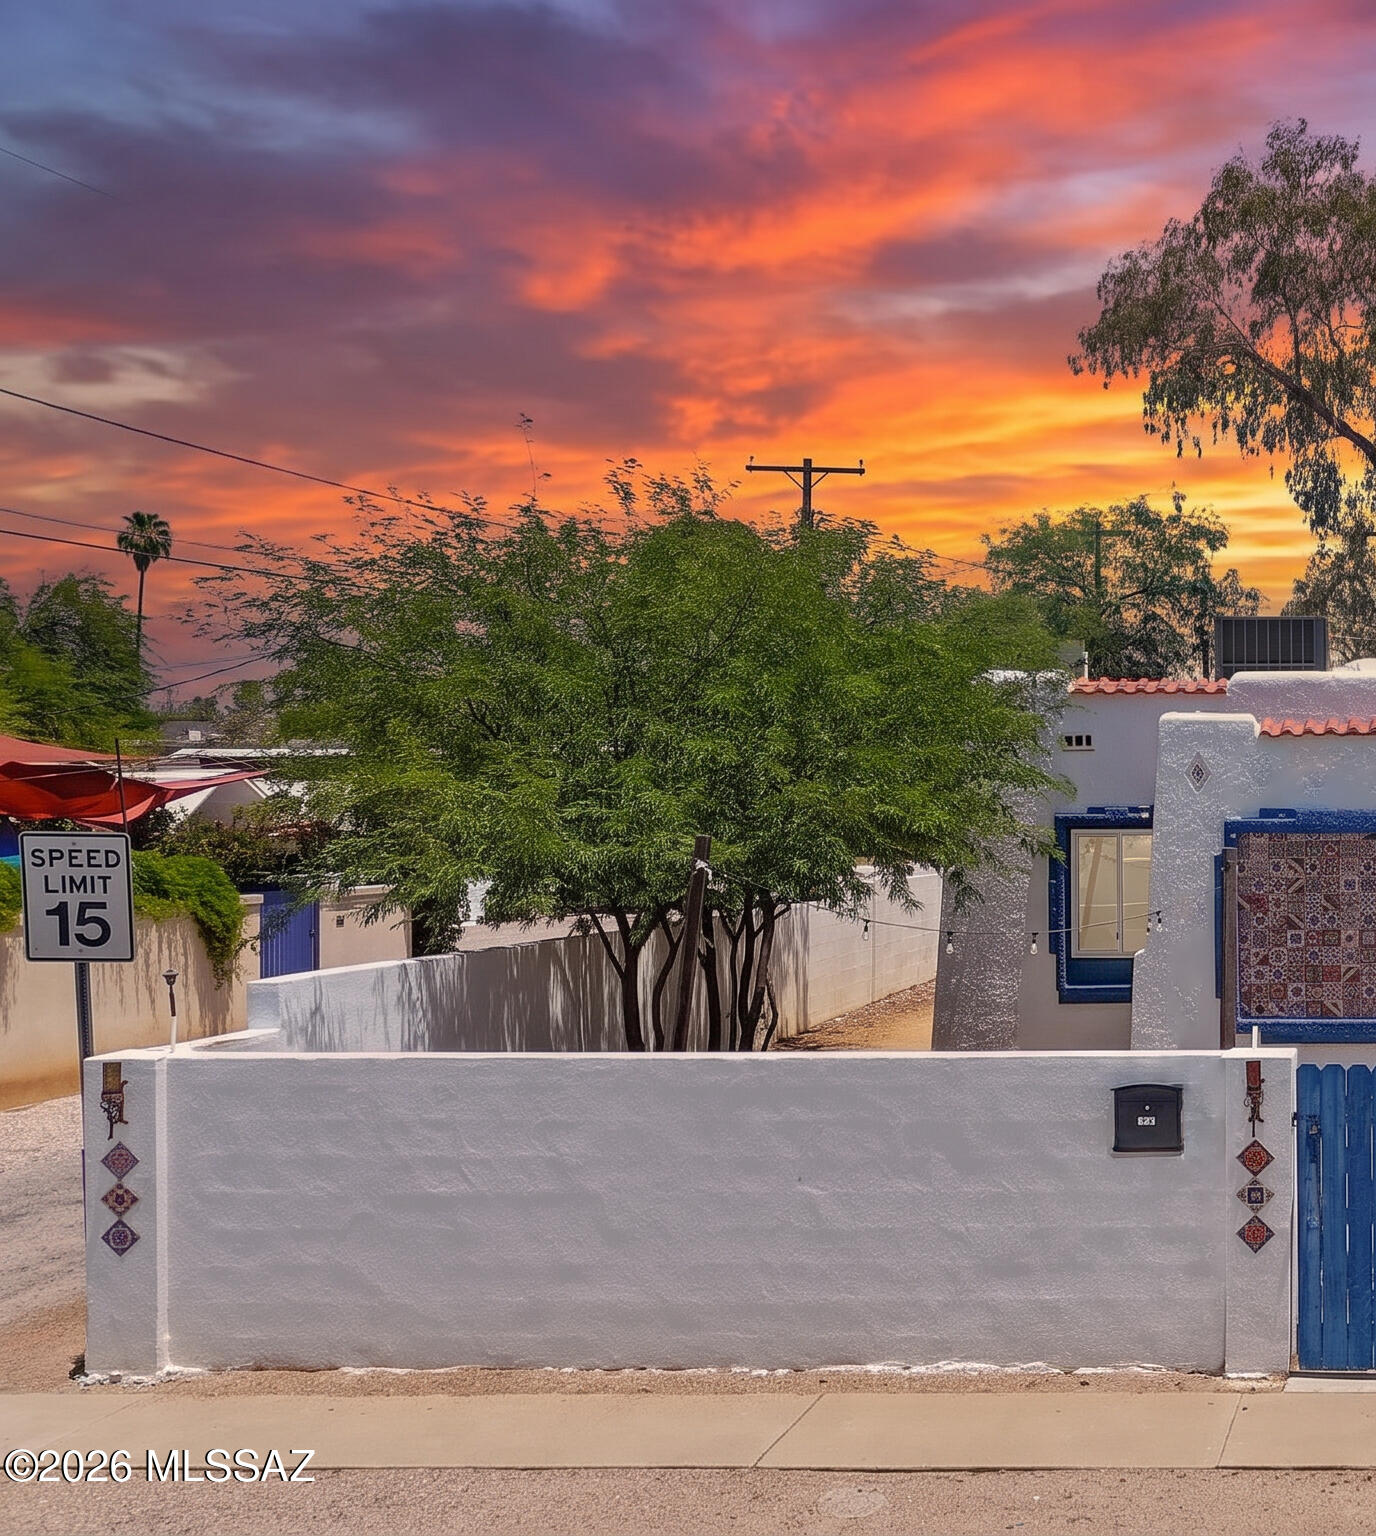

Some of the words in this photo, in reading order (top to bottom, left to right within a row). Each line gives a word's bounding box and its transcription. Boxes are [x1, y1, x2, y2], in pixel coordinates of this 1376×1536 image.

[31, 848, 121, 868] SPEED
[44, 875, 112, 894] LIMIT
[45, 901, 112, 948] 15
